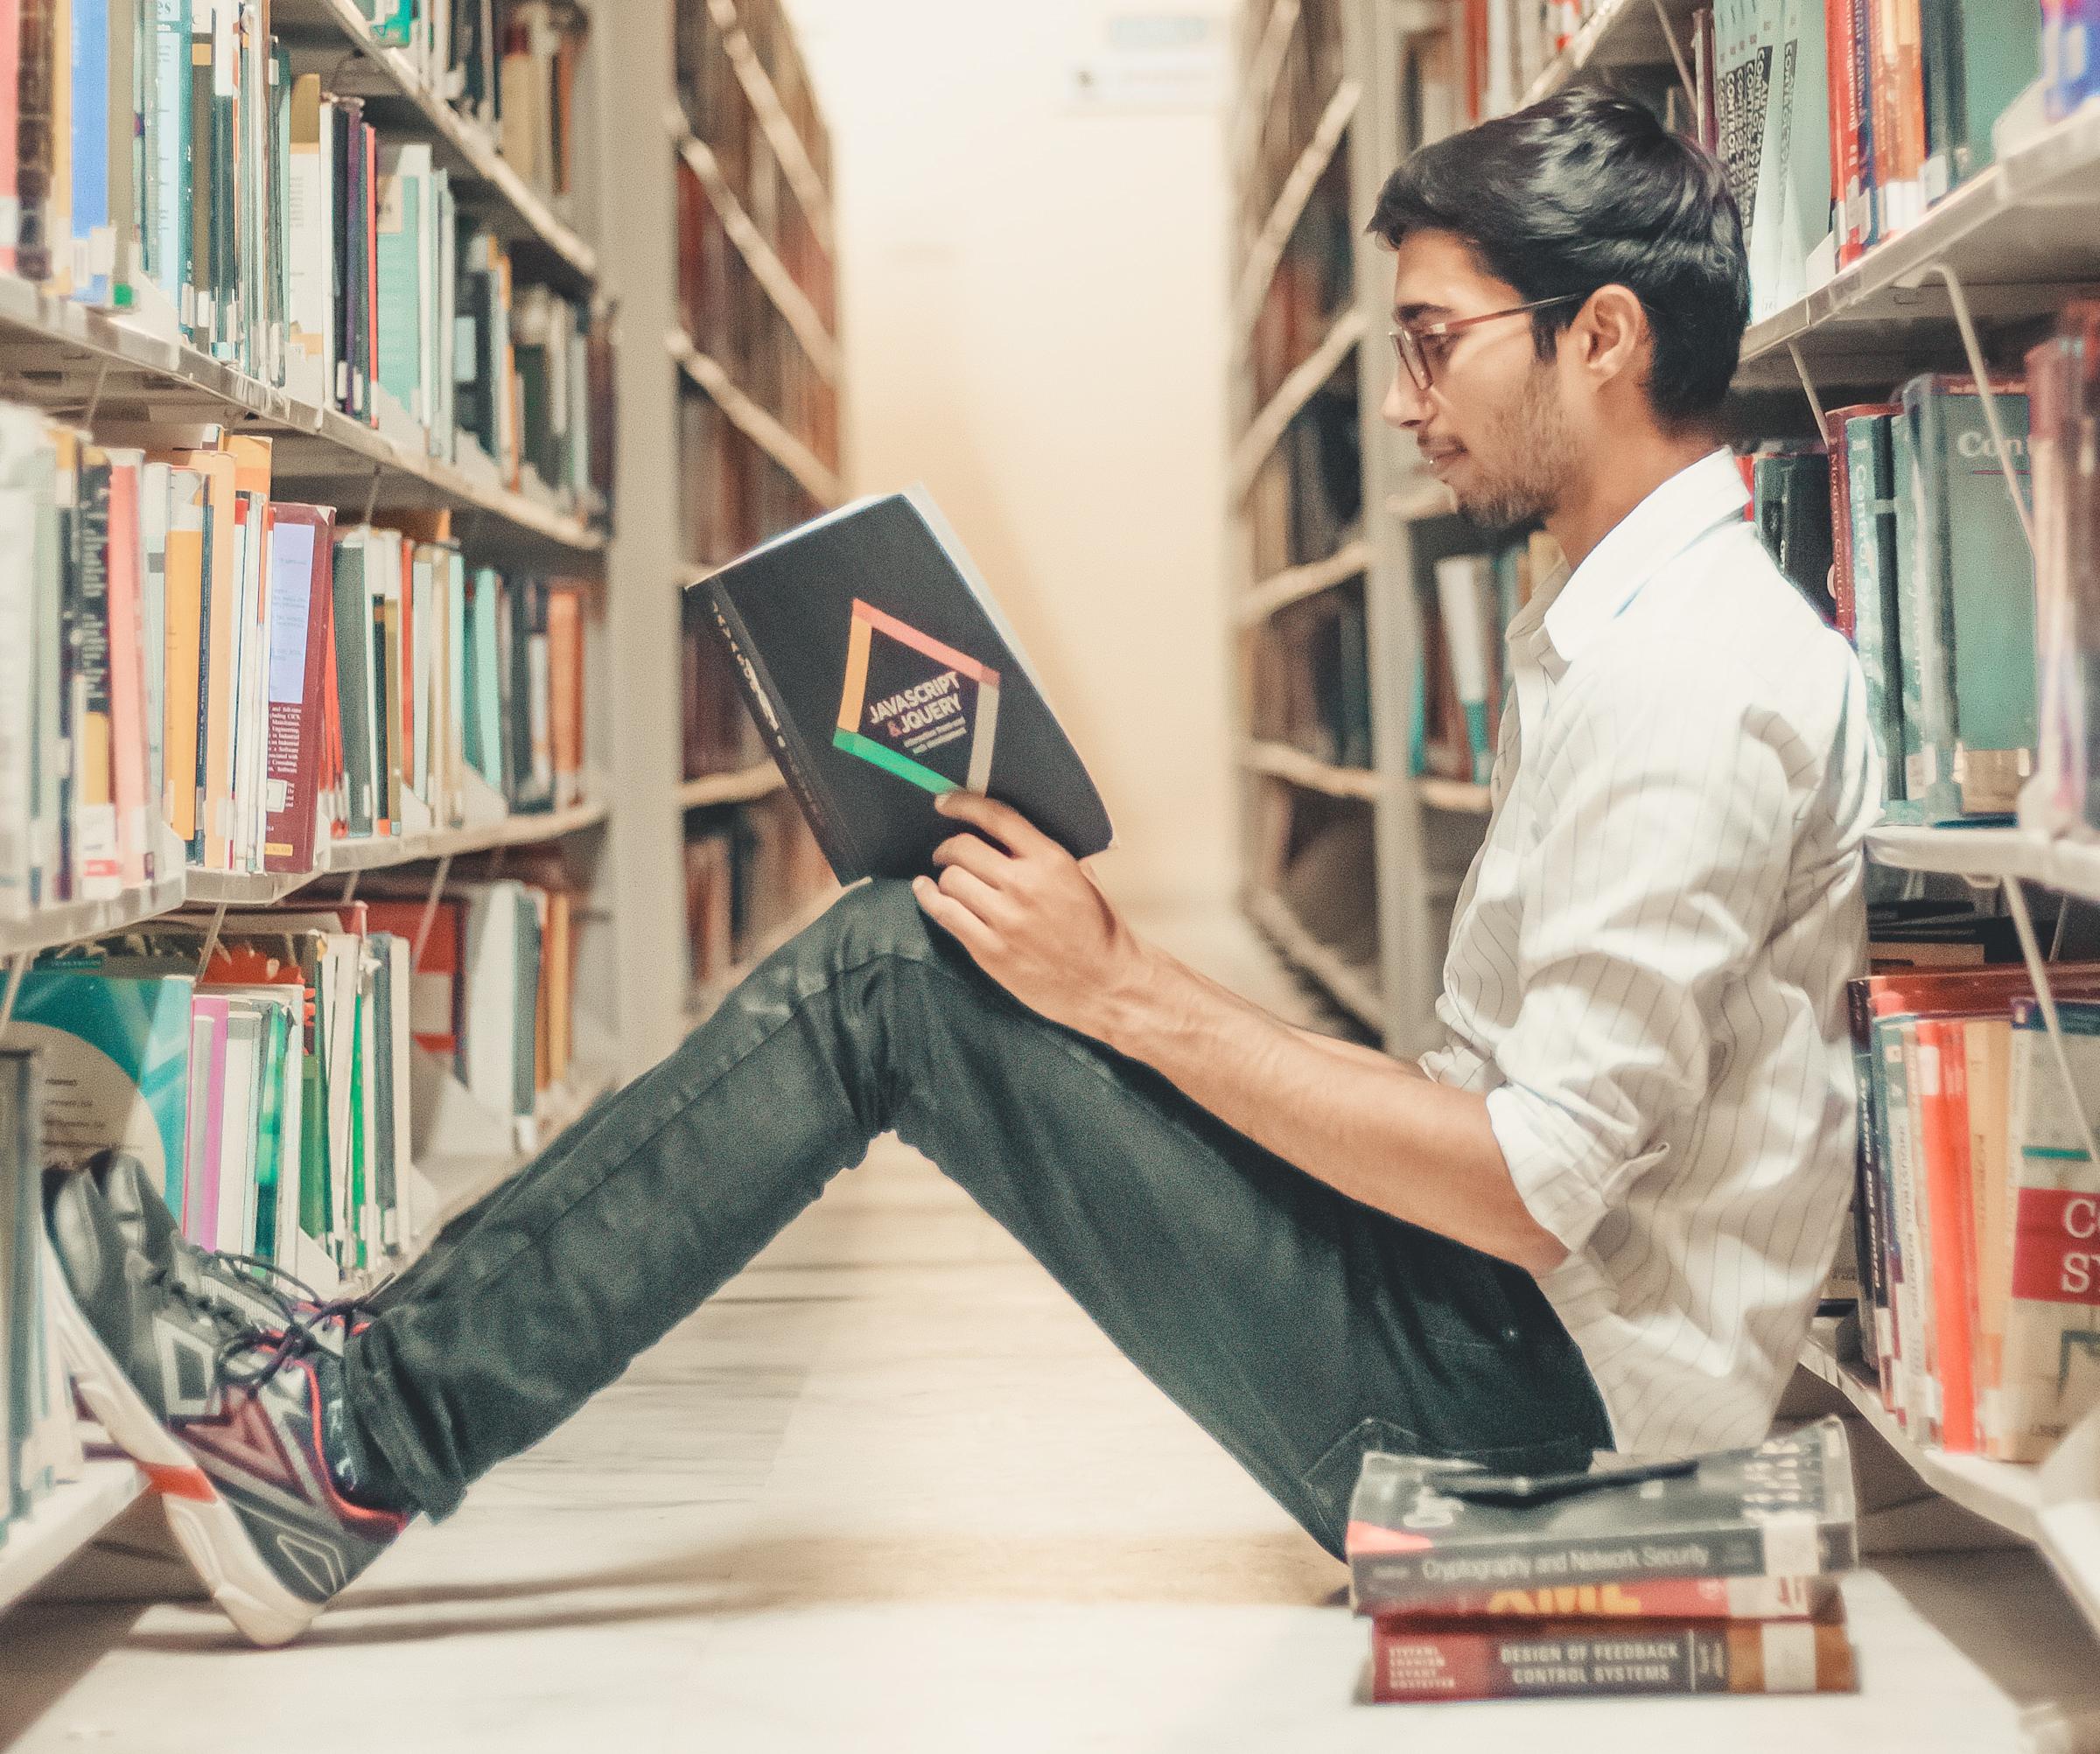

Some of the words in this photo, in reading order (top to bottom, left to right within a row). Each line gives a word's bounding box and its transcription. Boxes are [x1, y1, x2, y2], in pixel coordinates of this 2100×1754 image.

[1727, 72, 1737, 159] CONTROL
[1752, 48, 1765, 138] CONTROL
[1752, 79, 1768, 194] AUTOMATIC
[1830, 452, 1840, 531] Modern
[1856, 464, 1870, 568] Control
[1834, 537, 1845, 614] Control
[870, 671, 960, 724] JAVASCRIPT
[900, 693, 962, 734] JQUERY
[1866, 1170, 1875, 1208] and
[2063, 1198, 2100, 1239] C
[1422, 1553, 1530, 1582] Cryptography
[1534, 1552, 1568, 1575] and
[1570, 1549, 1638, 1572] Network
[1639, 1543, 1710, 1568] Security
[1501, 1644, 1563, 1664] DESIGN
[1565, 1642, 1588, 1662] OF
[1592, 1639, 1679, 1661] FEEDBACK
[1511, 1664, 1588, 1685] CONTROL
[1593, 1662, 1670, 1683] SYSTEMS
